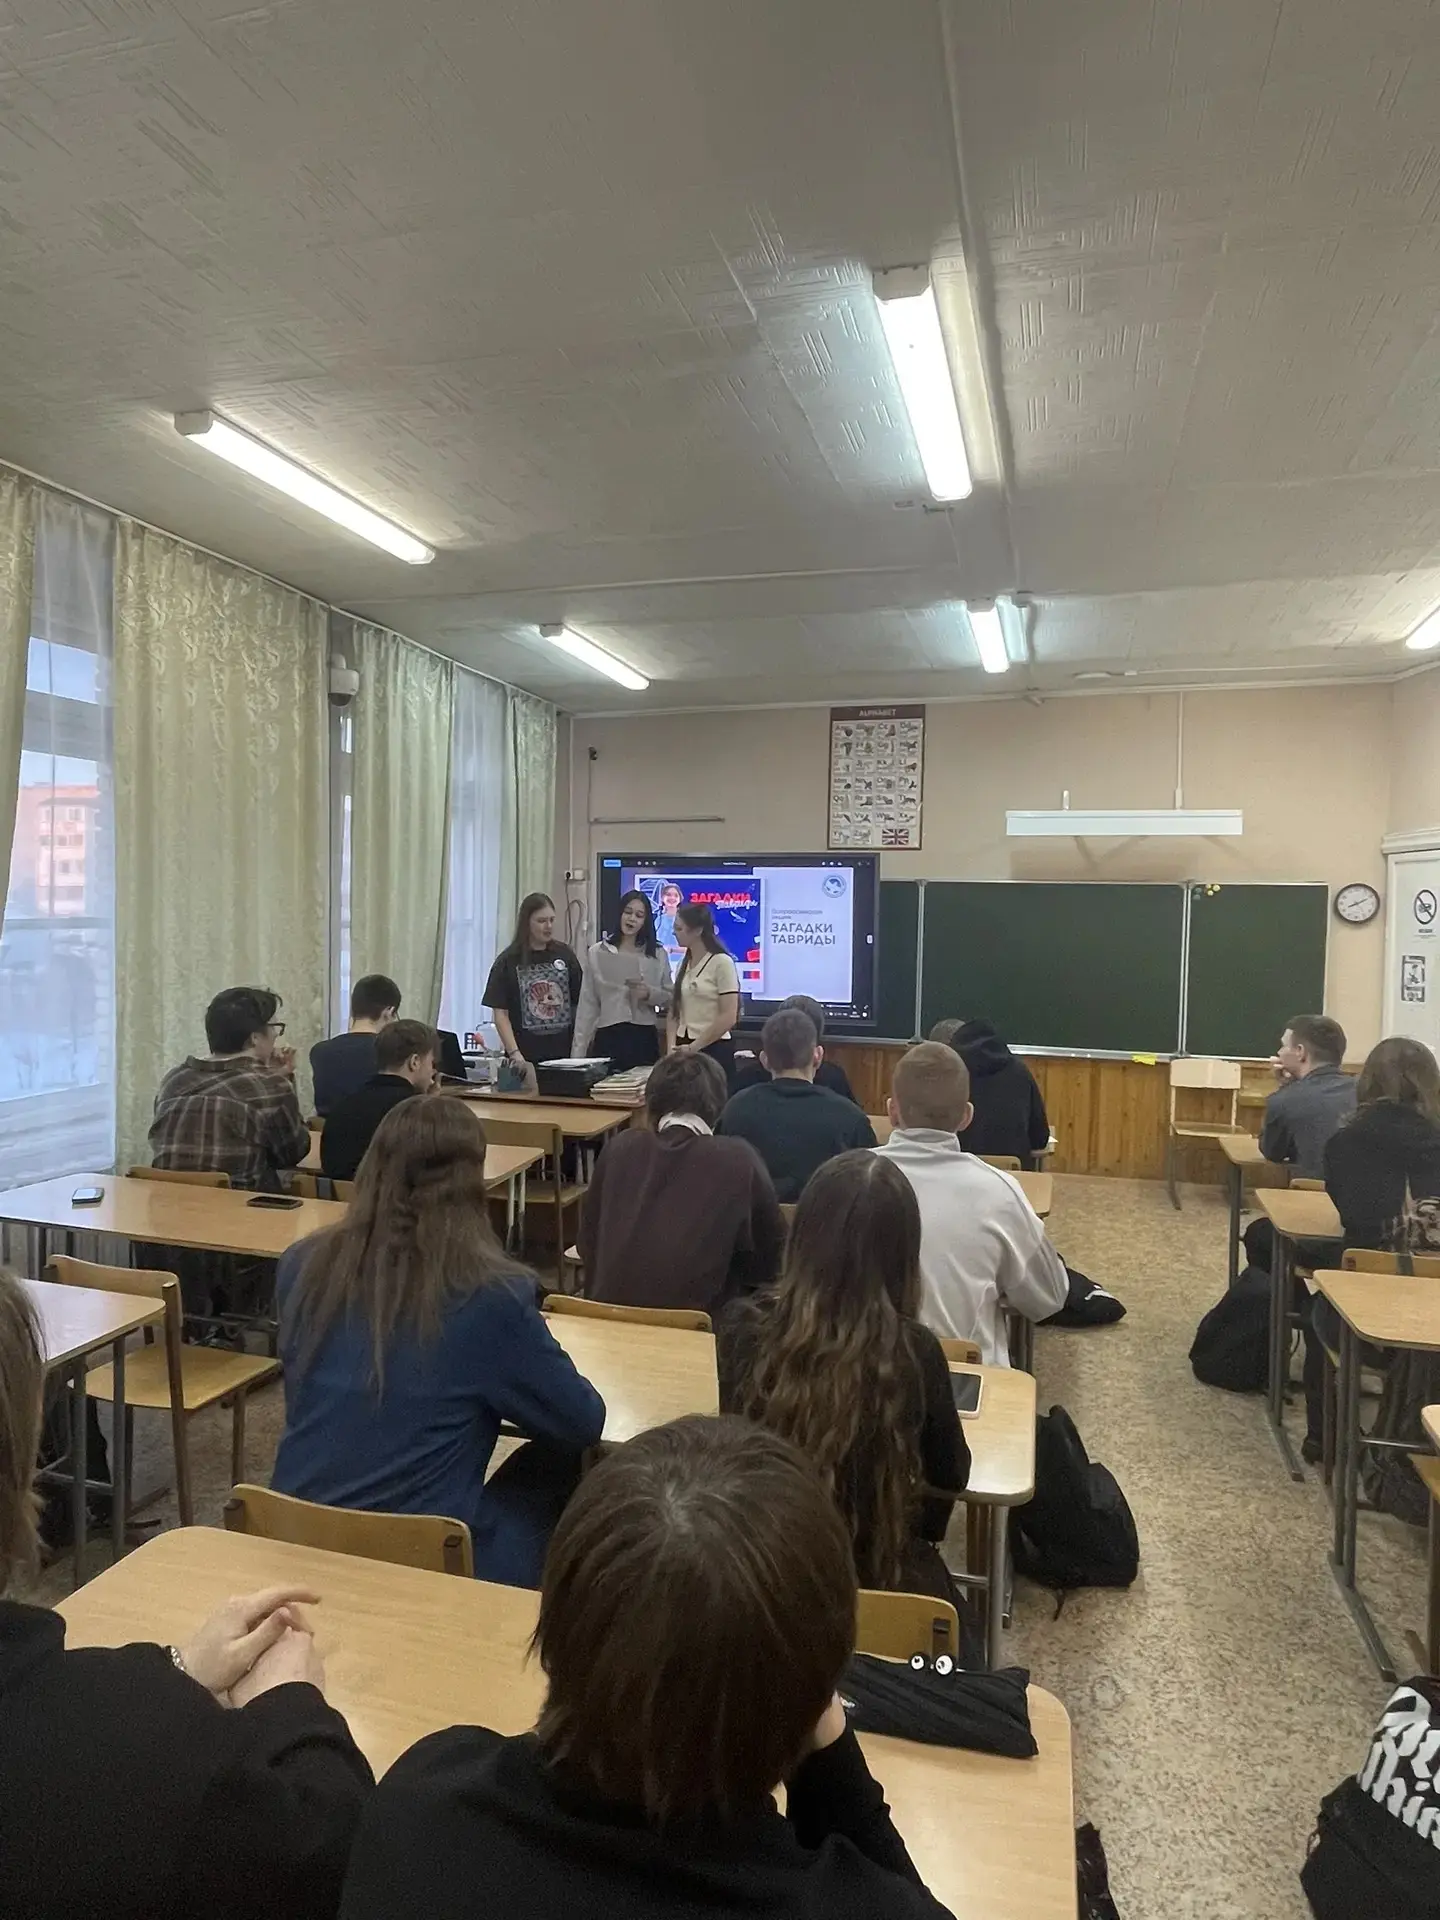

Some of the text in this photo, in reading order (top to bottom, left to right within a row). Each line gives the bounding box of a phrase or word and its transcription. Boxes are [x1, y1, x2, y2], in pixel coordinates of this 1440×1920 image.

[859, 709, 896, 717] ALPHABET
[690, 892, 751, 903] ЗАГАДКИ
[771, 922, 833, 934] ЗАГАДКИ
[771, 934, 836, 946] ТАВРИДЫ
